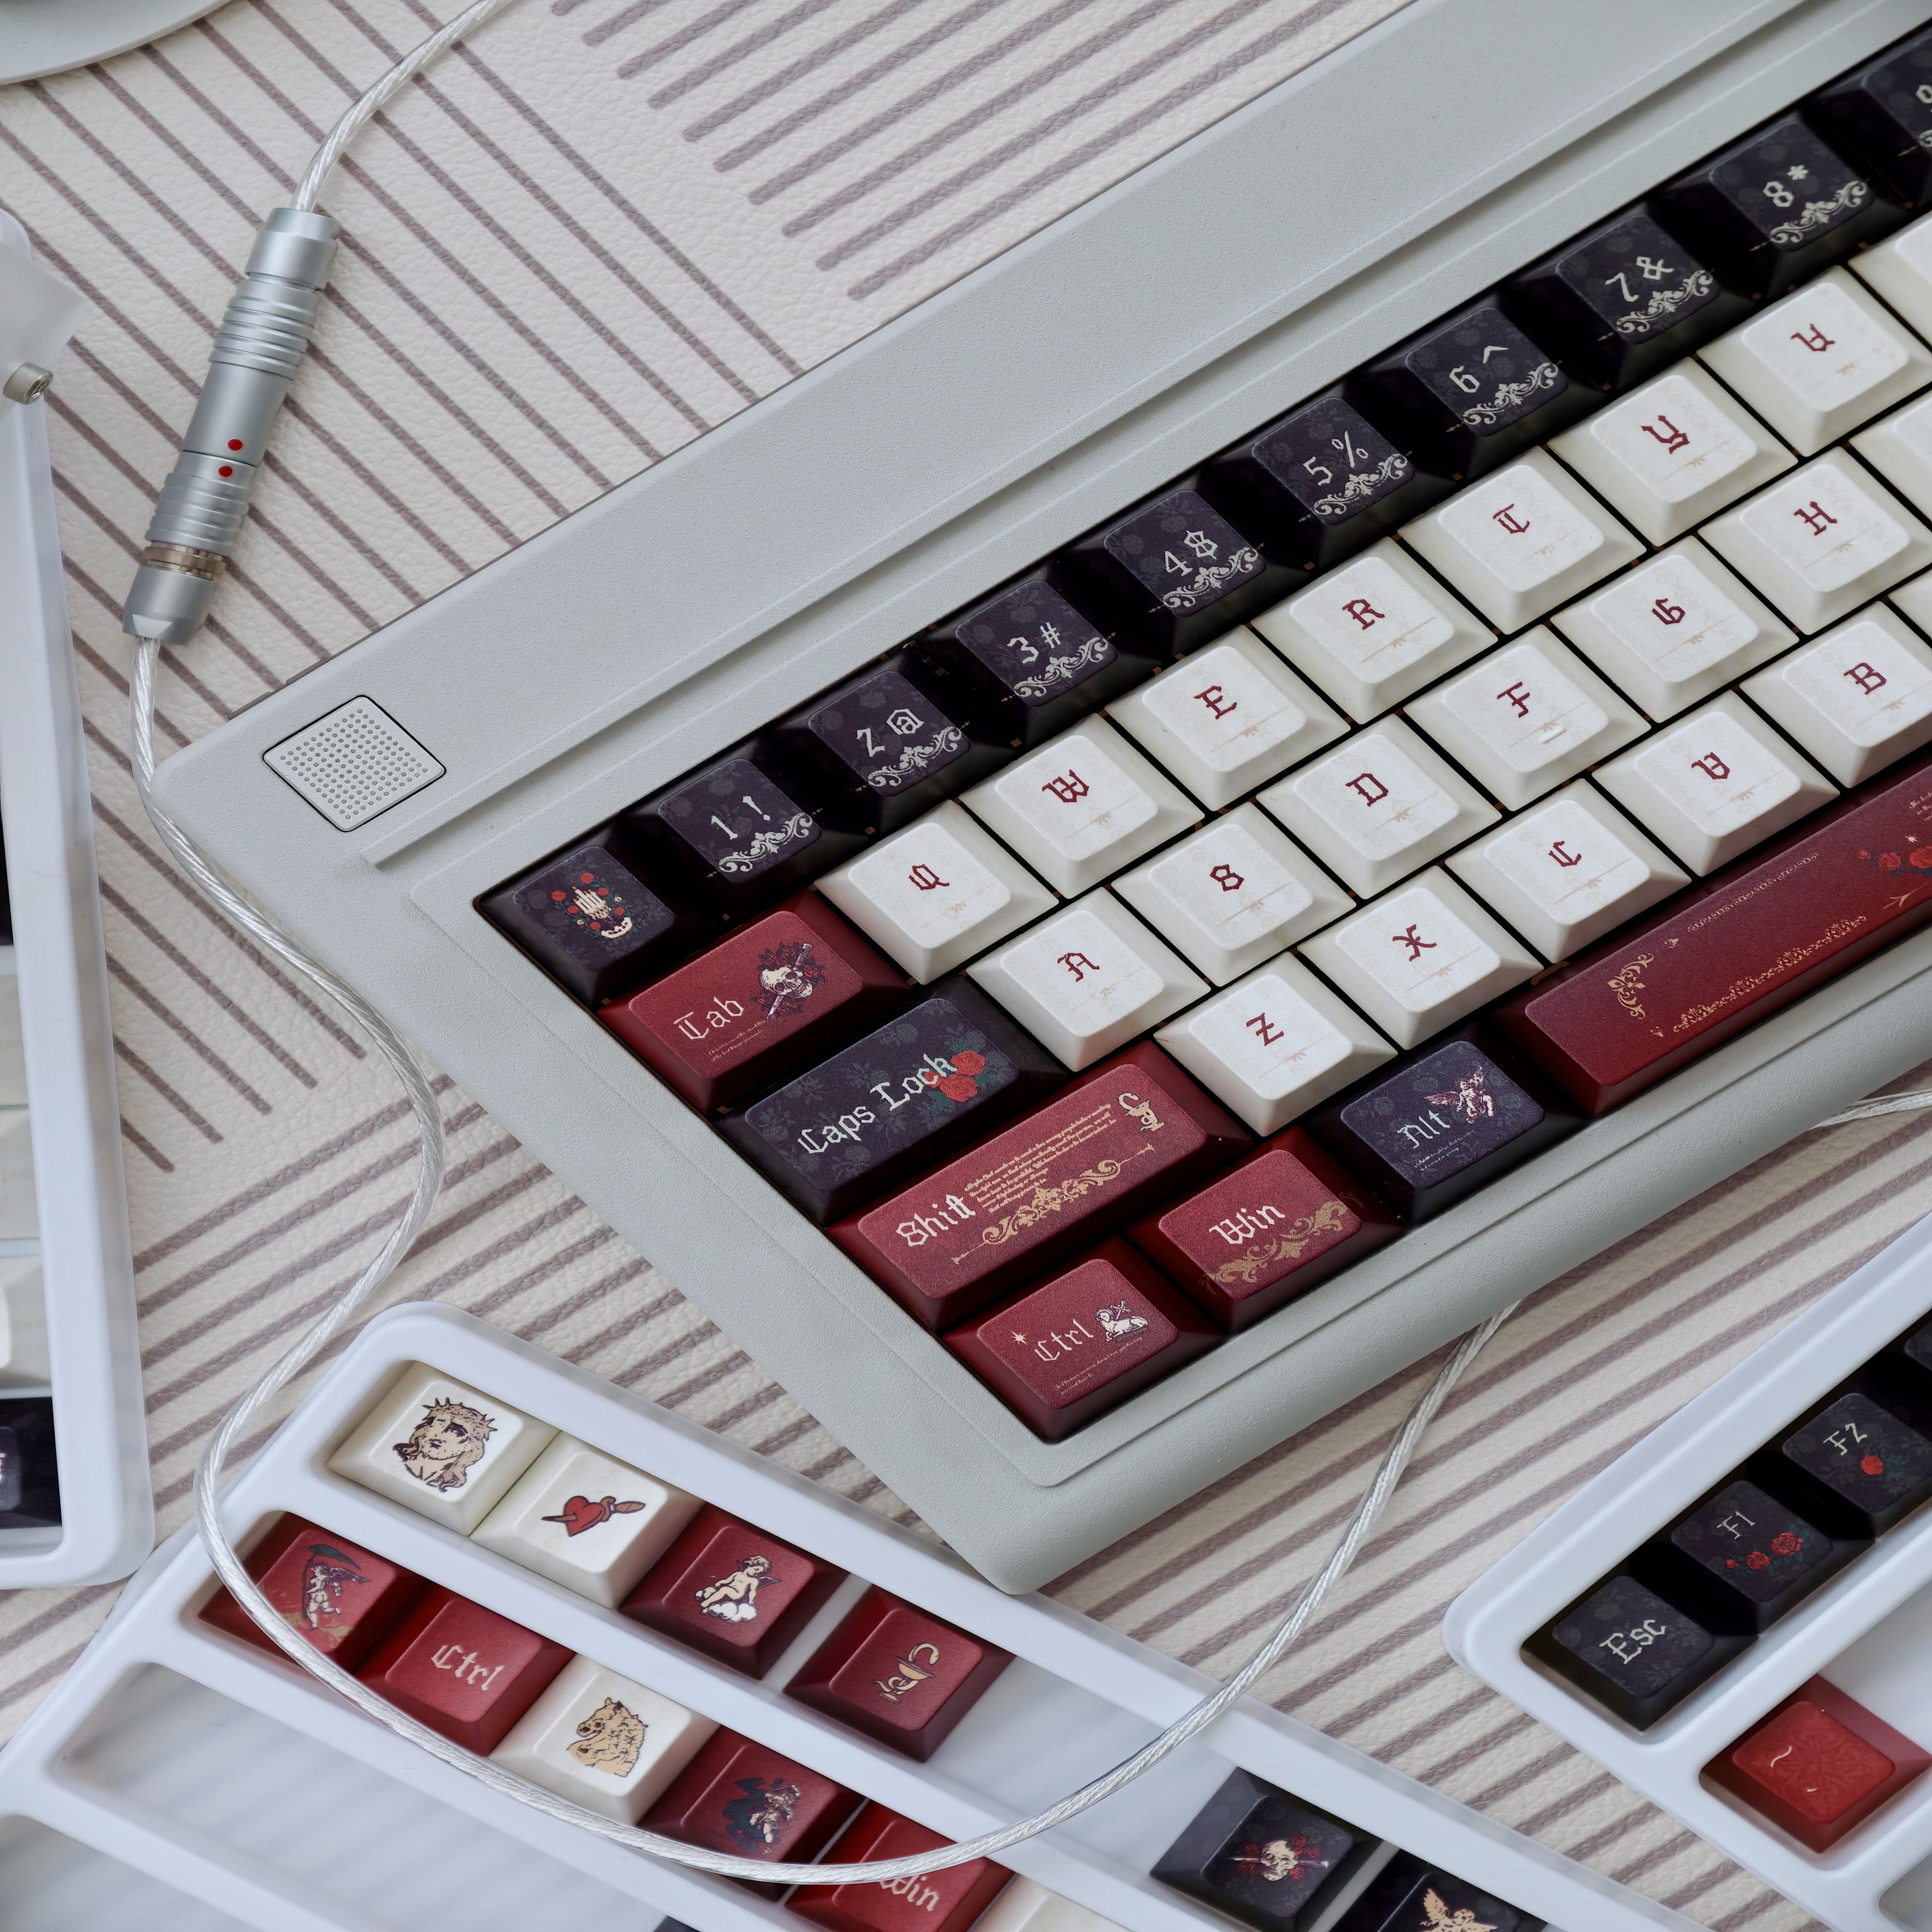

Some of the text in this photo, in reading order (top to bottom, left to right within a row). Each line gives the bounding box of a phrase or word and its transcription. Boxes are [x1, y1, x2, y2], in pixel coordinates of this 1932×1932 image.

[1492, 503, 1530, 534] T
[1794, 501, 1837, 536] H
[1342, 599, 1385, 630] R
[1843, 662, 1887, 695] B
[1193, 685, 1237, 720] E
[1497, 681, 1530, 718] F
[1041, 769, 1090, 803] W
[1345, 773, 1389, 807] D
[1548, 840, 1582, 867] C
[908, 864, 950, 891] Q
[1392, 924, 1437, 962] X
[674, 997, 744, 1040] Tab
[1246, 1012, 1284, 1046] Z
[797, 1053, 957, 1154] Caps Lock
[1397, 1109, 1451, 1149] Alt
[895, 1193, 977, 1248] Shift
[1209, 1205, 1285, 1244] Win
[1034, 1318, 1094, 1361] Ctrl
[1823, 1422, 1868, 1456] F2
[1716, 1511, 1755, 1540] F1
[1599, 1619, 1666, 1664] Esc
[431, 1645, 504, 1691] Ctrl
